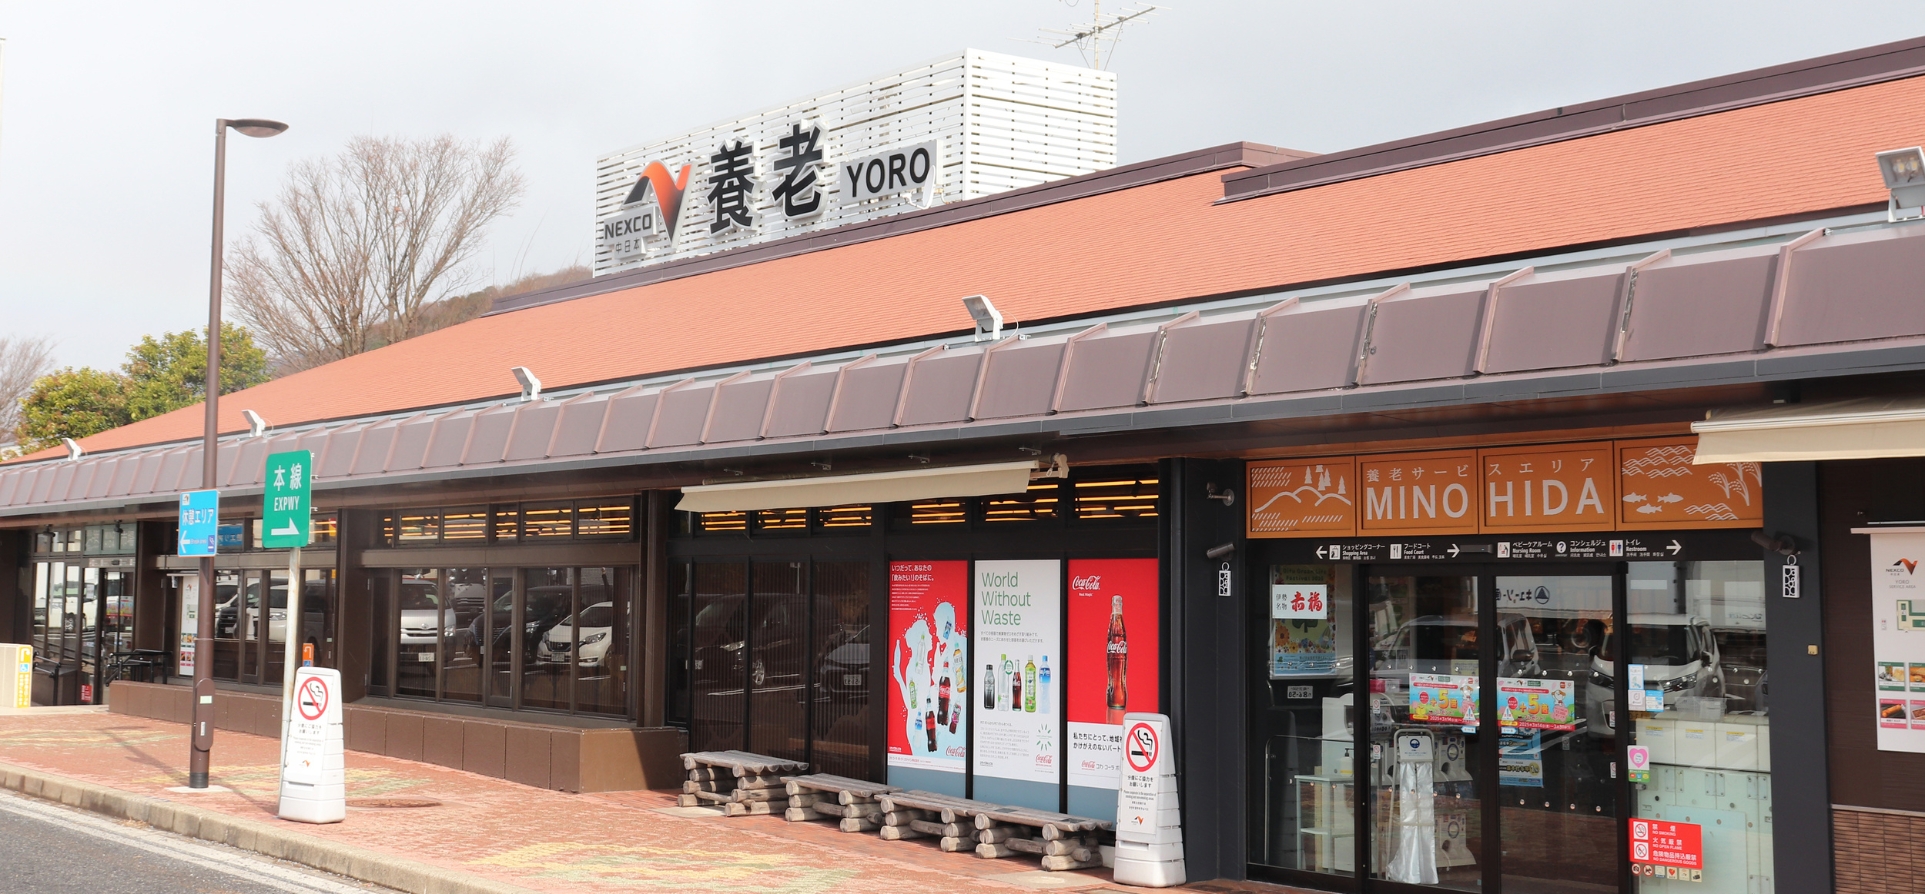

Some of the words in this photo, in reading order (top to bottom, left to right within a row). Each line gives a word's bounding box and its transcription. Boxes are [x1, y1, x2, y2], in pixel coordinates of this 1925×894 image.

[706, 123, 825, 236] 養老
[846, 147, 931, 198] YORO
[605, 213, 652, 240] NEXCO
[616, 237, 640, 254] 中日本
[273, 462, 302, 492] 本線
[273, 496, 300, 512] EXPWY
[1366, 483, 1469, 520] MINO
[1489, 477, 1605, 517] HIDA
[981, 571, 1018, 588] World
[981, 590, 1031, 607] Without
[1291, 591, 1323, 612] 赤福
[981, 609, 1021, 626] Waste
